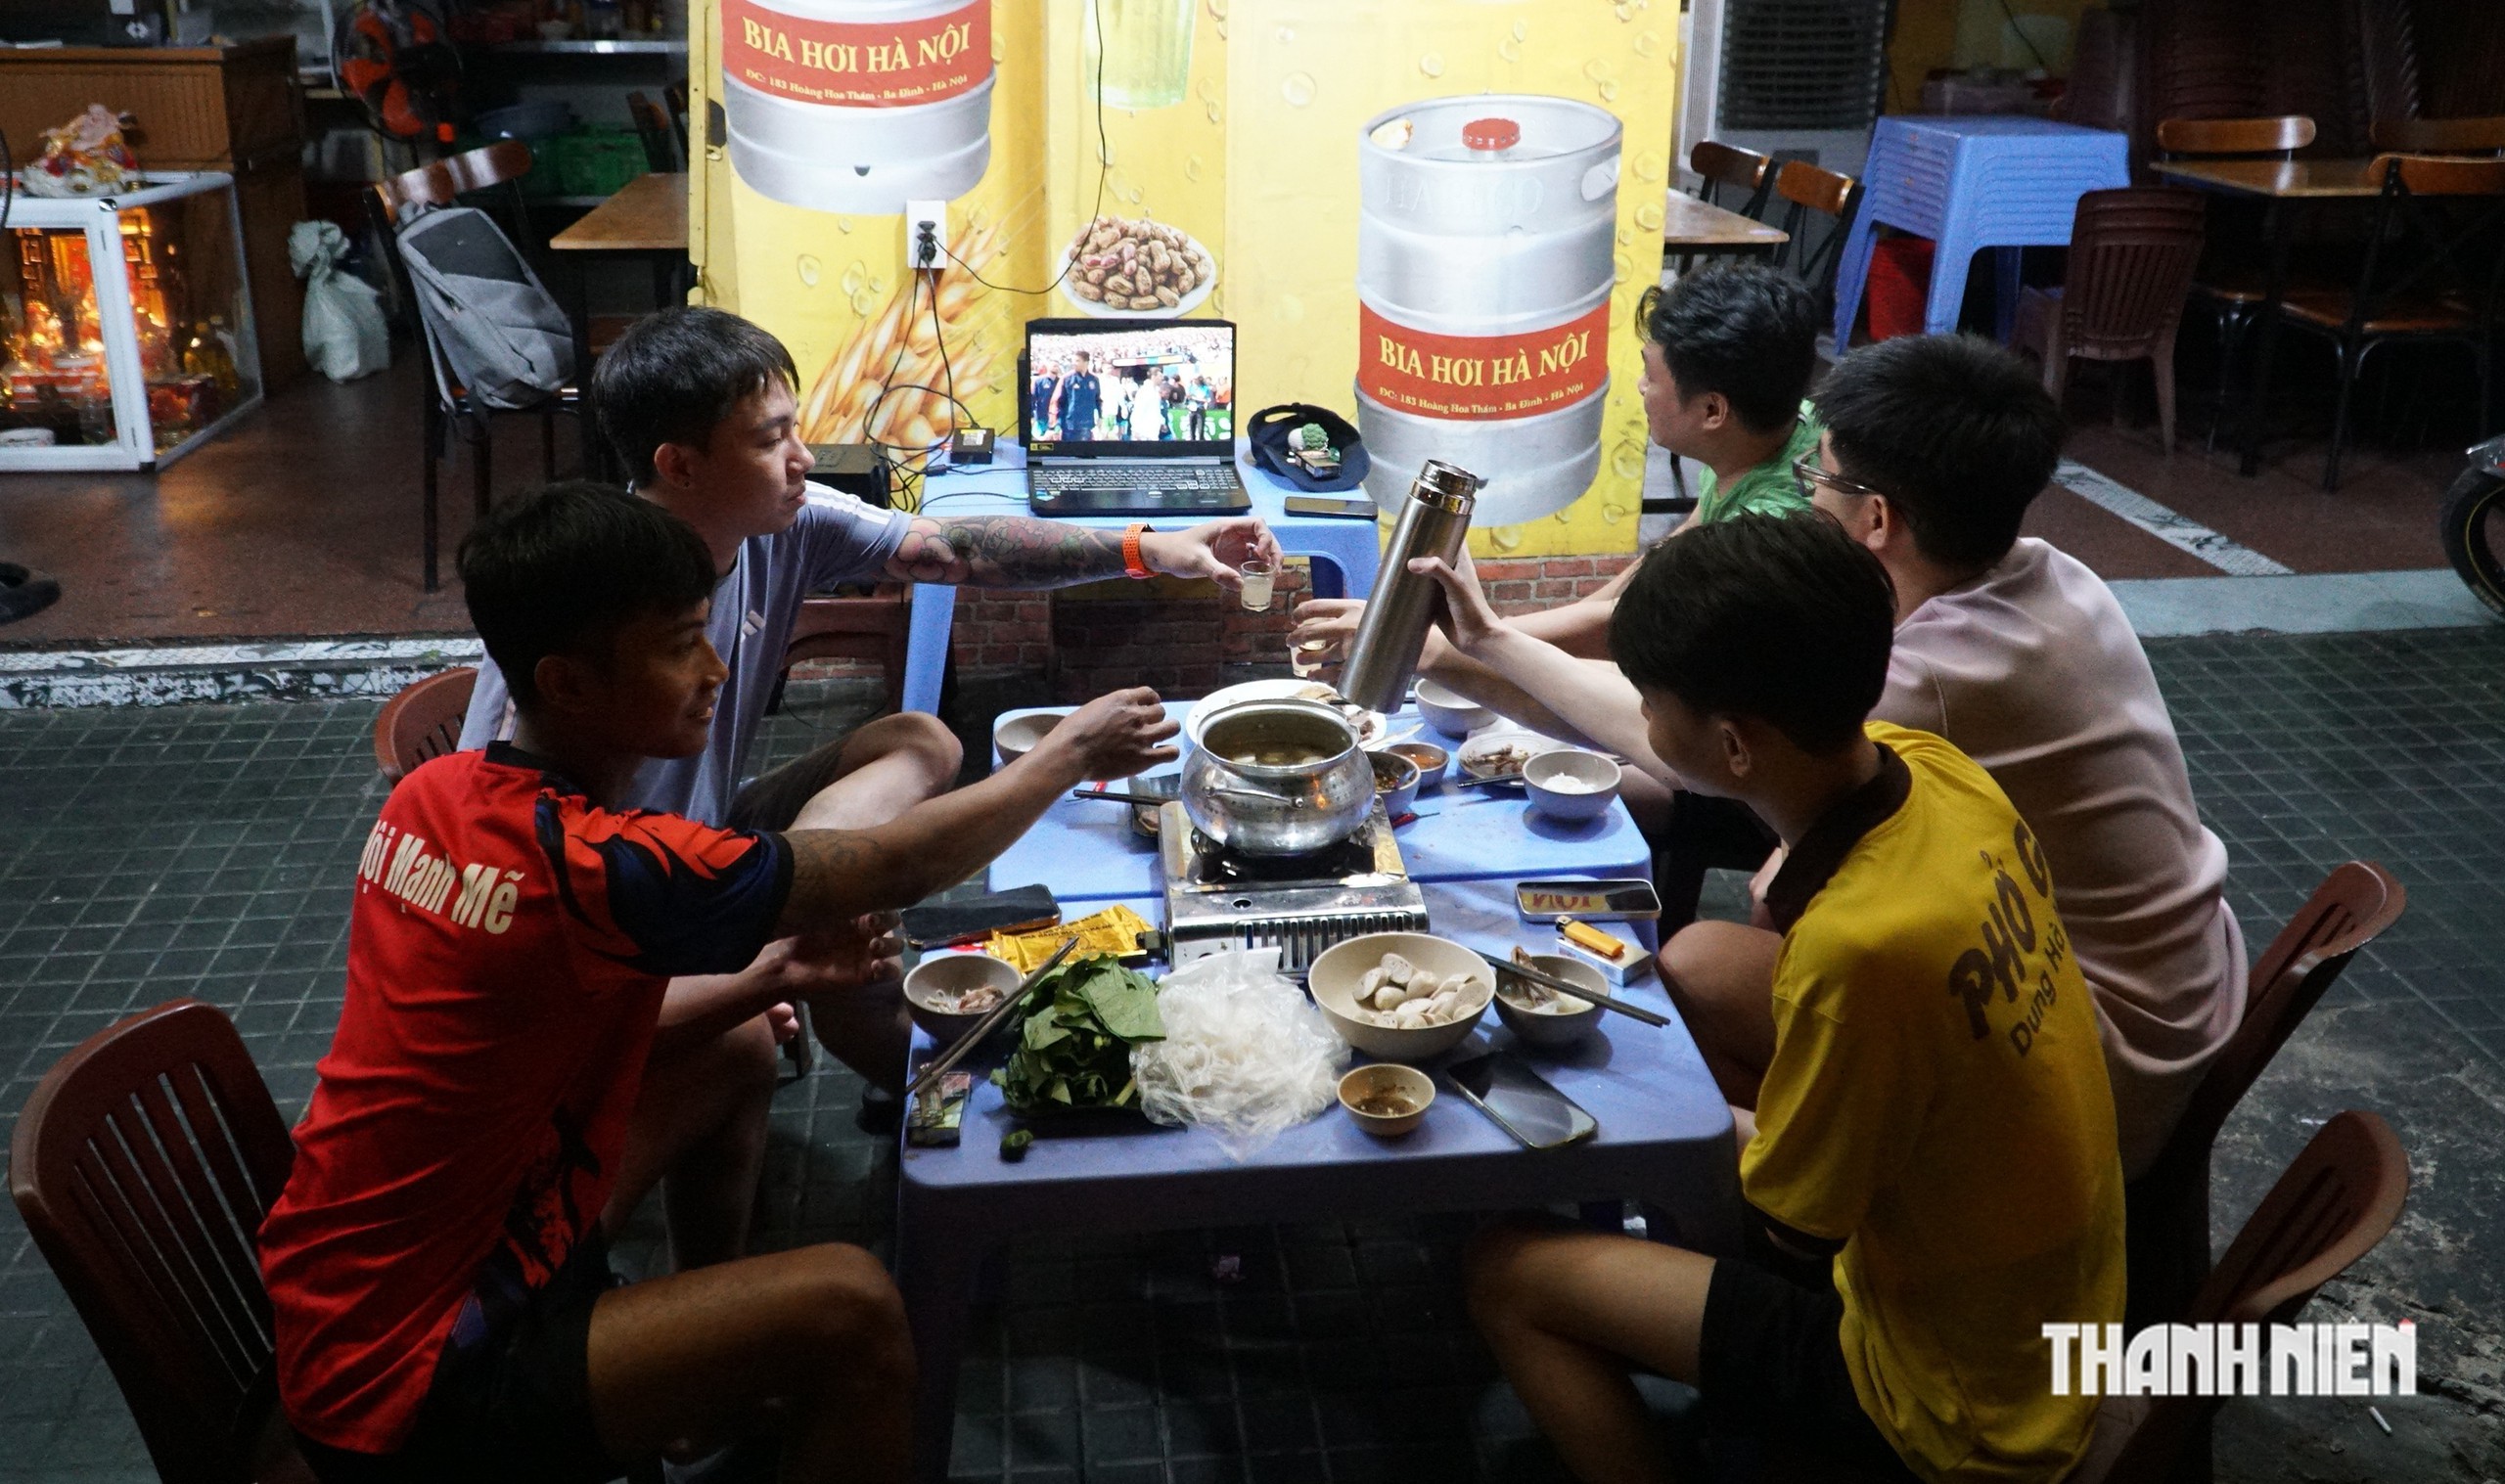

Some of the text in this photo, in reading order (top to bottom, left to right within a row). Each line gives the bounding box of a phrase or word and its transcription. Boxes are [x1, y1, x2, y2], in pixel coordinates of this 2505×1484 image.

[743, 17, 972, 73] BIA HƠI HÀ NỘI
[769, 76, 787, 90] 183
[789, 81, 823, 100] Hoàng
[823, 88, 845, 100] Hoa
[883, 89, 896, 100] Ba
[898, 86, 924, 99] Đình
[932, 80, 947, 92] Hà
[949, 73, 968, 88] Nội
[1379, 330, 1590, 387] BIA HƠI HÀ NỘI
[1379, 386, 1397, 401] ĐC:
[1399, 393, 1417, 406] 183
[1418, 398, 1450, 415] Hoàng
[1450, 403, 1470, 414] Hoa
[1471, 403, 1497, 414] Thám
[1504, 402, 1517, 412] Ba
[1519, 396, 1543, 409] Đình
[1550, 389, 1565, 402] Hà
[1567, 383, 1584, 397] Nội
[384, 832, 457, 915] Mạnh
[450, 862, 525, 935] Mẽ
